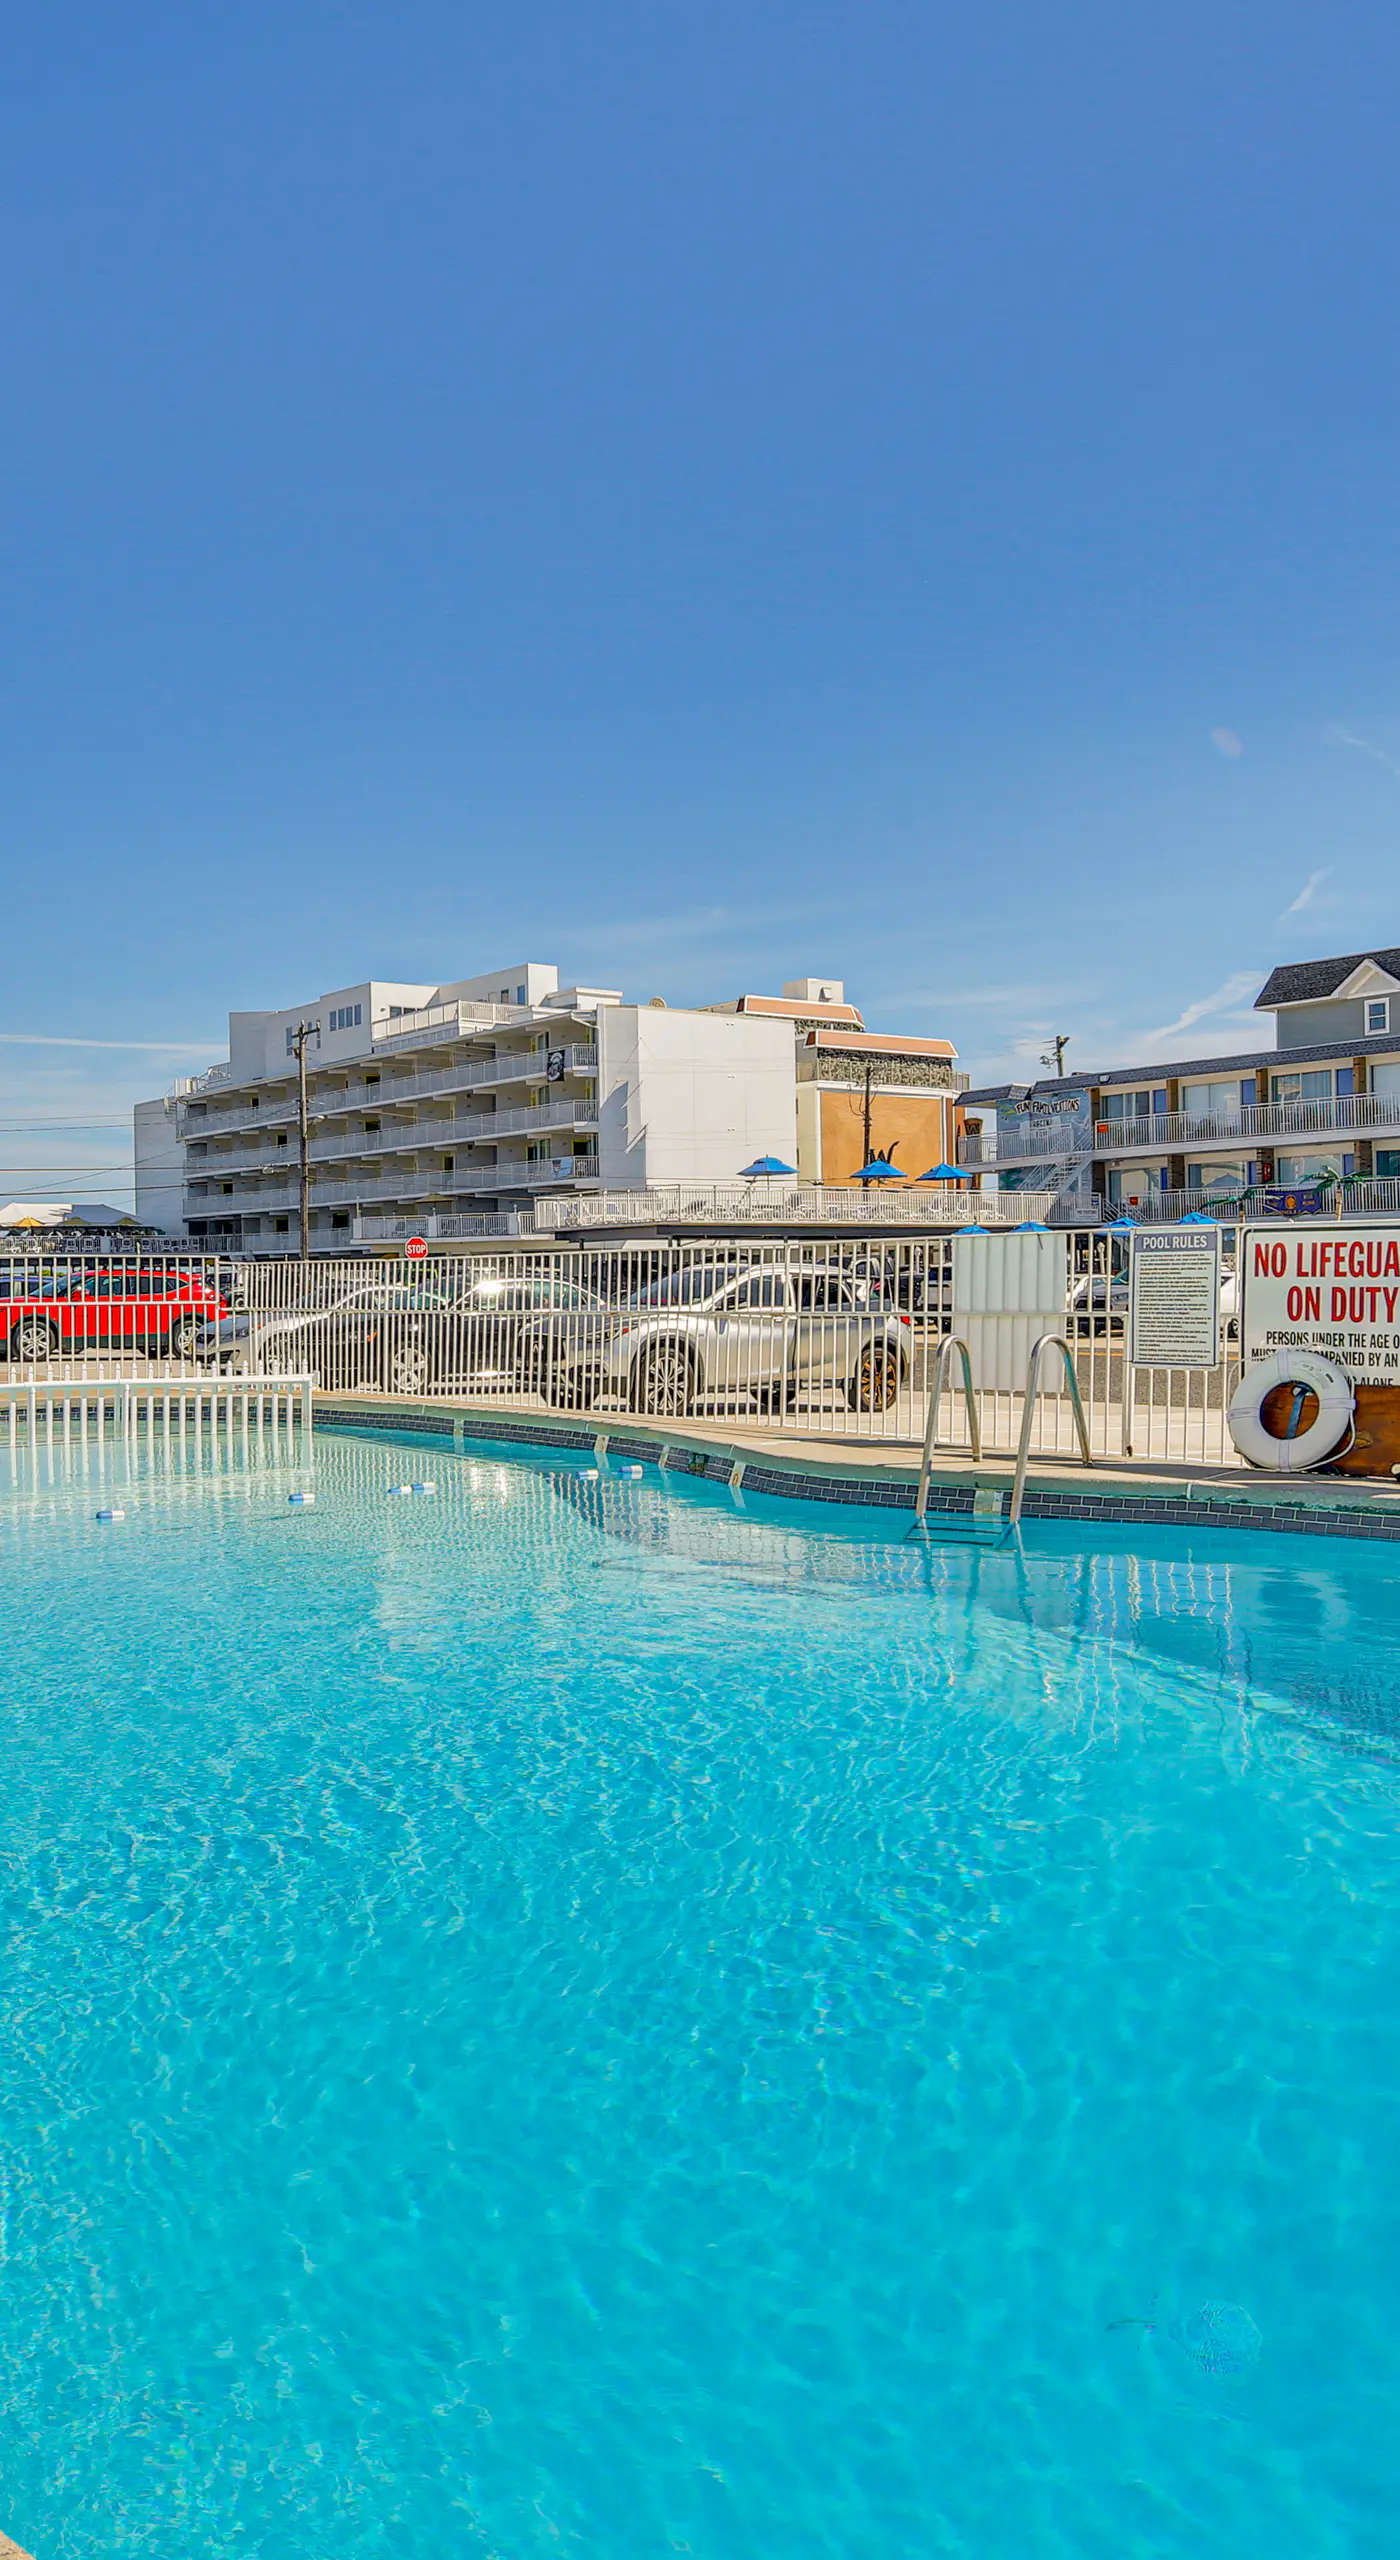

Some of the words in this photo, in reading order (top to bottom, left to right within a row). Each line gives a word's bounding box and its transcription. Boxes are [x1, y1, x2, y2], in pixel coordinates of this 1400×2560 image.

[407, 1244, 426, 1254] STOP
[1143, 1236, 1170, 1249] POOL
[1172, 1235, 1208, 1249] RULES
[1254, 1242, 1287, 1278] NO
[1296, 1241, 1400, 1278] LIFEGUA
[1287, 1285, 1321, 1321] ON
[1331, 1286, 1399, 1323] DUTY
[1266, 1331, 1309, 1346] PERSONS
[1312, 1332, 1345, 1347] UNDER
[1348, 1333, 1367, 1348] THE
[1370, 1334, 1389, 1348] AGE
[1368, 1352, 1381, 1367] BY
[1384, 1353, 1398, 1367] AN
